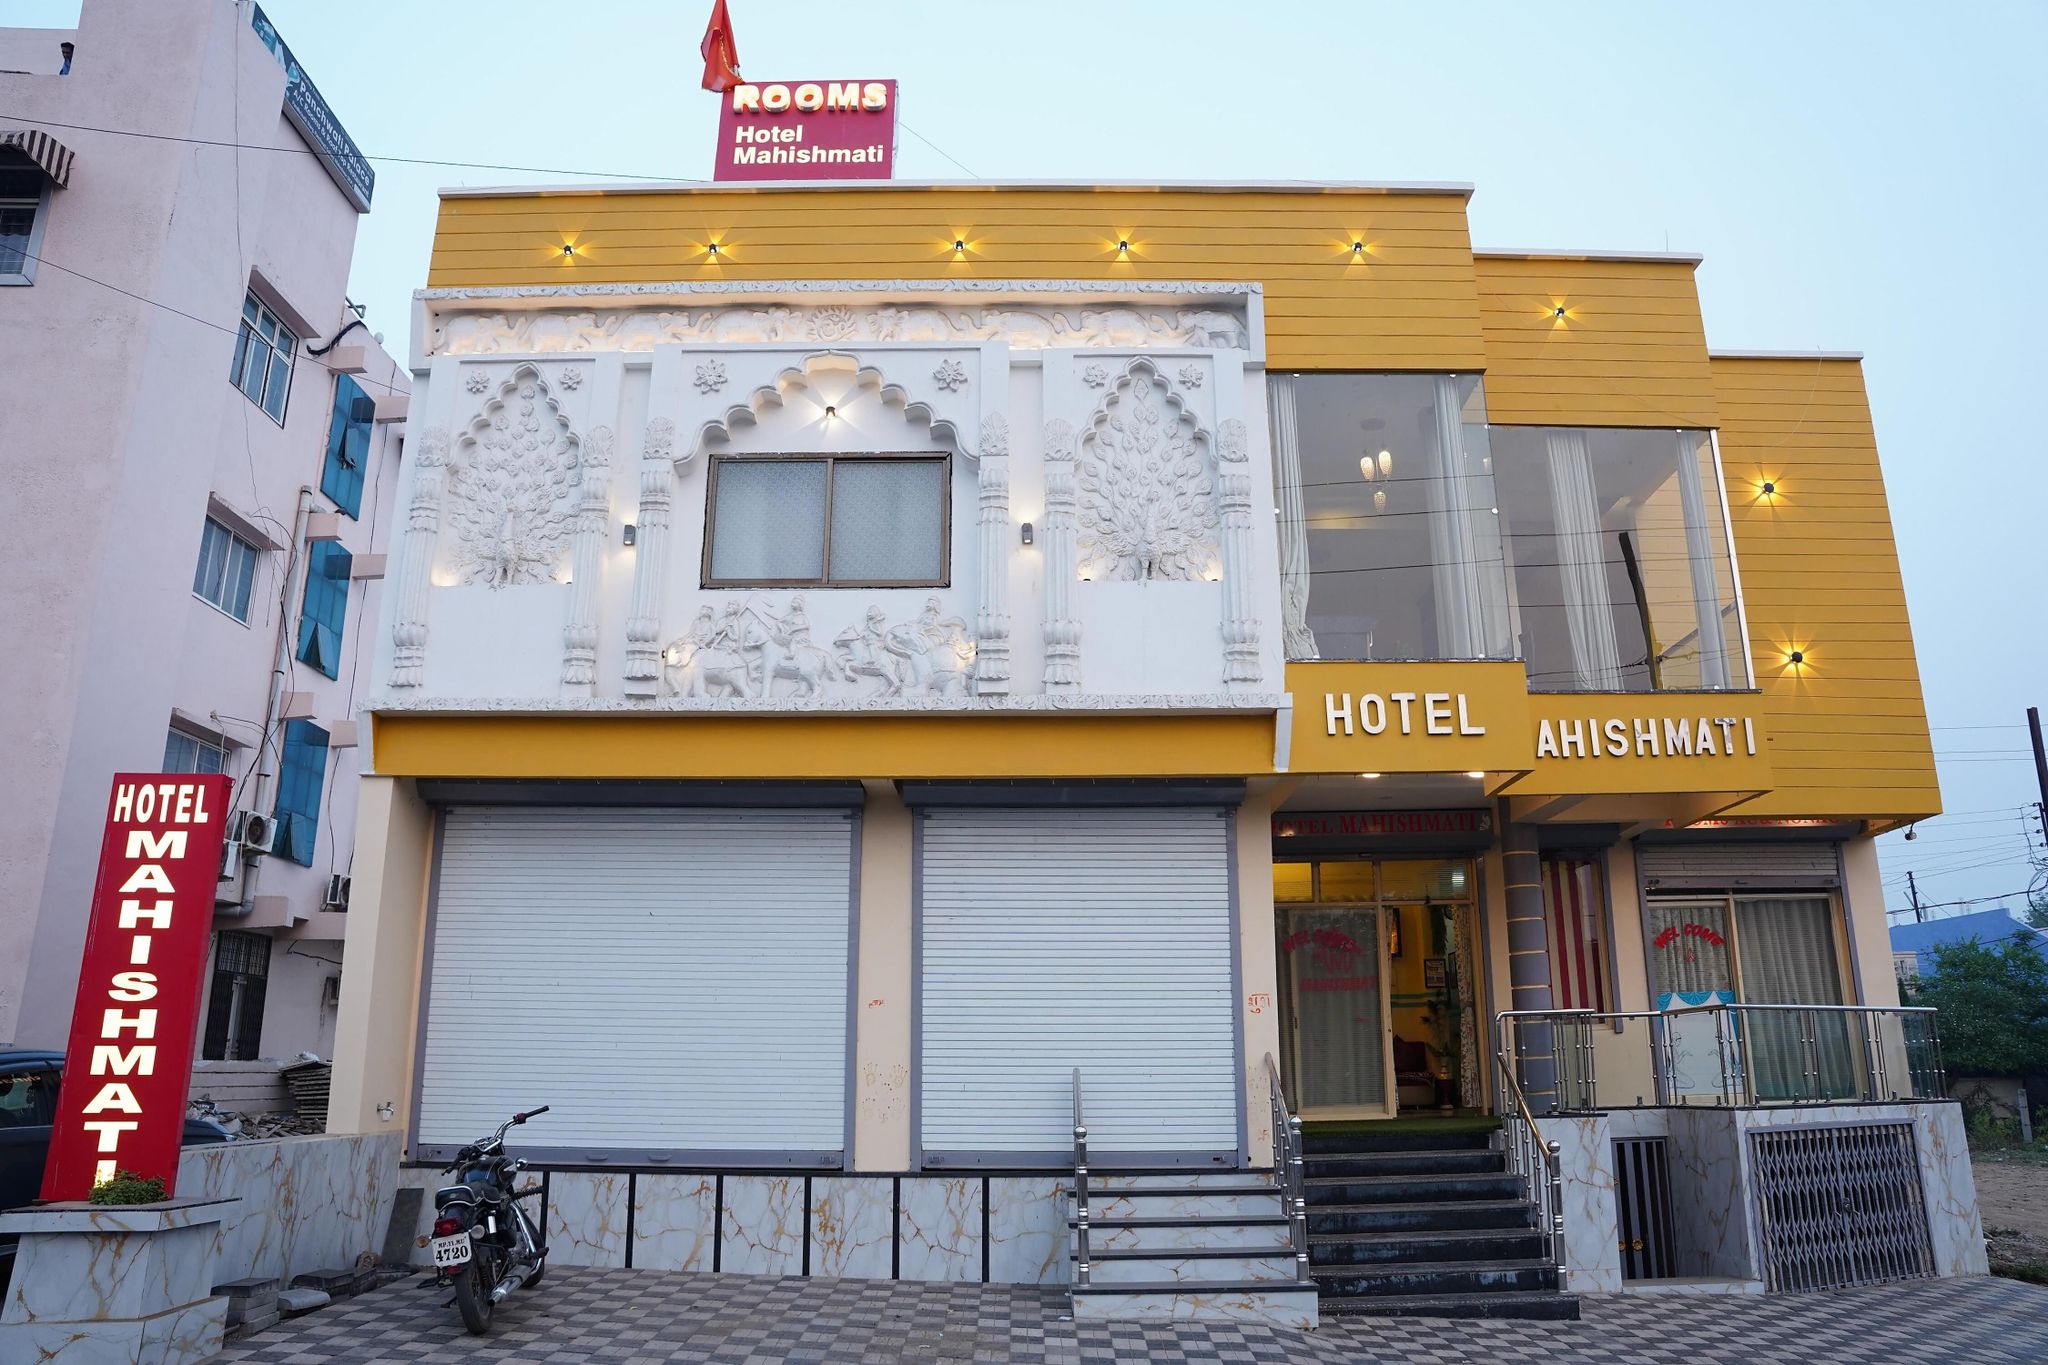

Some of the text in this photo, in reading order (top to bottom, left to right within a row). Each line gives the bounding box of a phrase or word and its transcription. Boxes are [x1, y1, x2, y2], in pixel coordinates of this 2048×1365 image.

[293, 89, 305, 106] A/C
[733, 83, 887, 114] ROOMS
[735, 125, 803, 144] Hotel
[344, 141, 370, 186] Palace
[733, 145, 884, 164] Mahishmati
[1325, 692, 1757, 758] HOTEL AHISHMATI
[113, 784, 208, 823] HOTEL
[1339, 812, 1475, 834] MAHISHMATI
[82, 830, 188, 1190] MAHISHMATI
[436, 1245, 468, 1262] 4720
